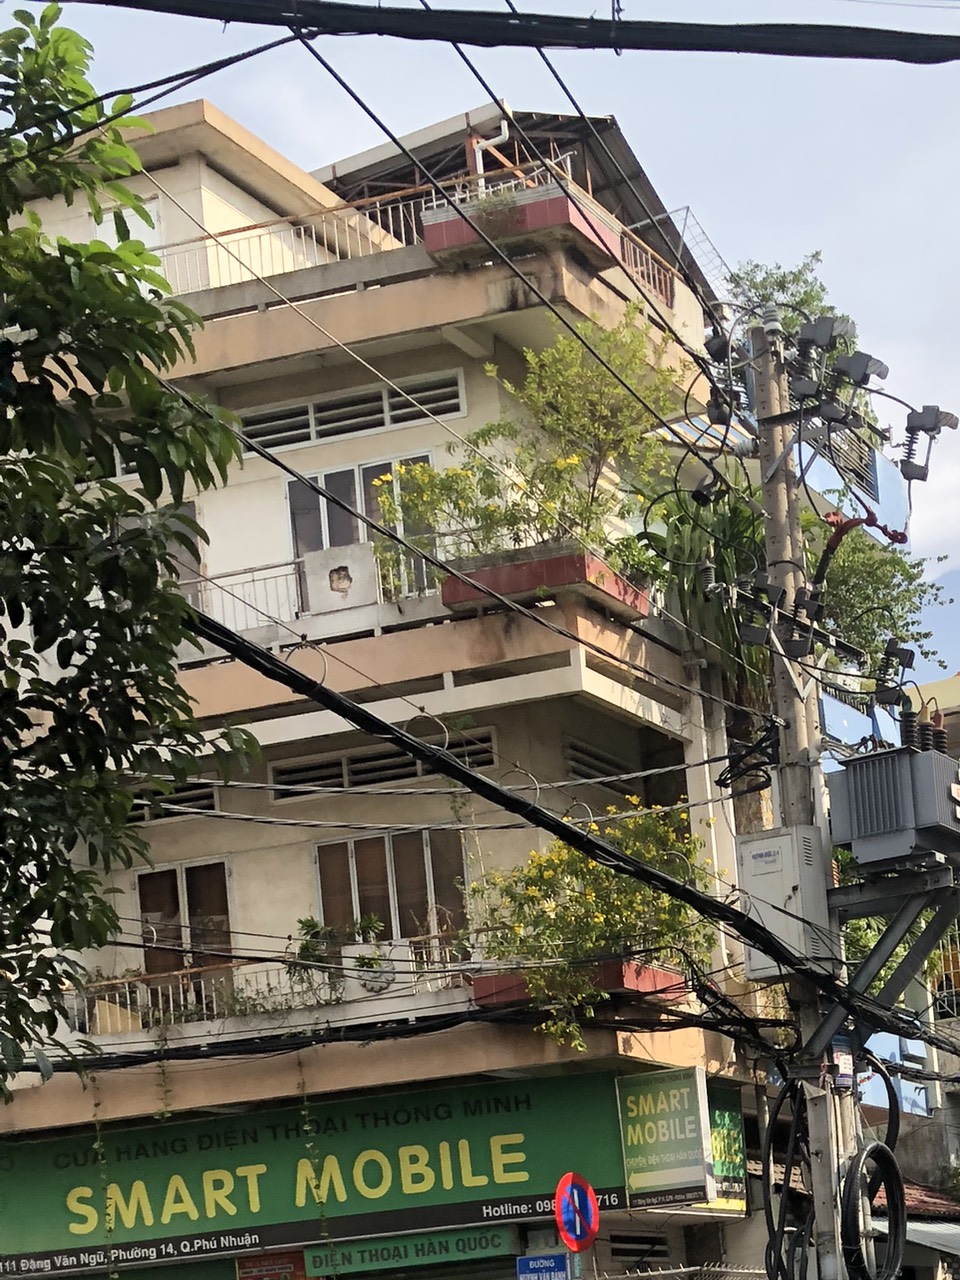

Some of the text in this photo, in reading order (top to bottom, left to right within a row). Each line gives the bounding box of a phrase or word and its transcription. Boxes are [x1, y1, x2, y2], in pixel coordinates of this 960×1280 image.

[462, 1093, 531, 1117] MINH
[626, 1087, 690, 1118] SMART
[627, 1115, 697, 1147] MOBILE
[66, 1132, 530, 1235] SMART MOBILE
[482, 1203, 533, 1218] Hotline:
[20, 1258, 51, 1272] Đặng
[54, 1254, 77, 1267] Văn
[80, 1251, 108, 1266] Ngữ,
[111, 1246, 157, 1260] Phường
[160, 1243, 178, 1256] 14,
[180, 1237, 217, 1253] Q.Phú
[220, 1233, 260, 1248] Nhuận
[357, 1245, 408, 1264] THOẠI
[414, 1238, 450, 1258] HÀN
[455, 1229, 502, 1254] QUỐC
[529, 1258, 555, 1269] ĐƯỜNG
